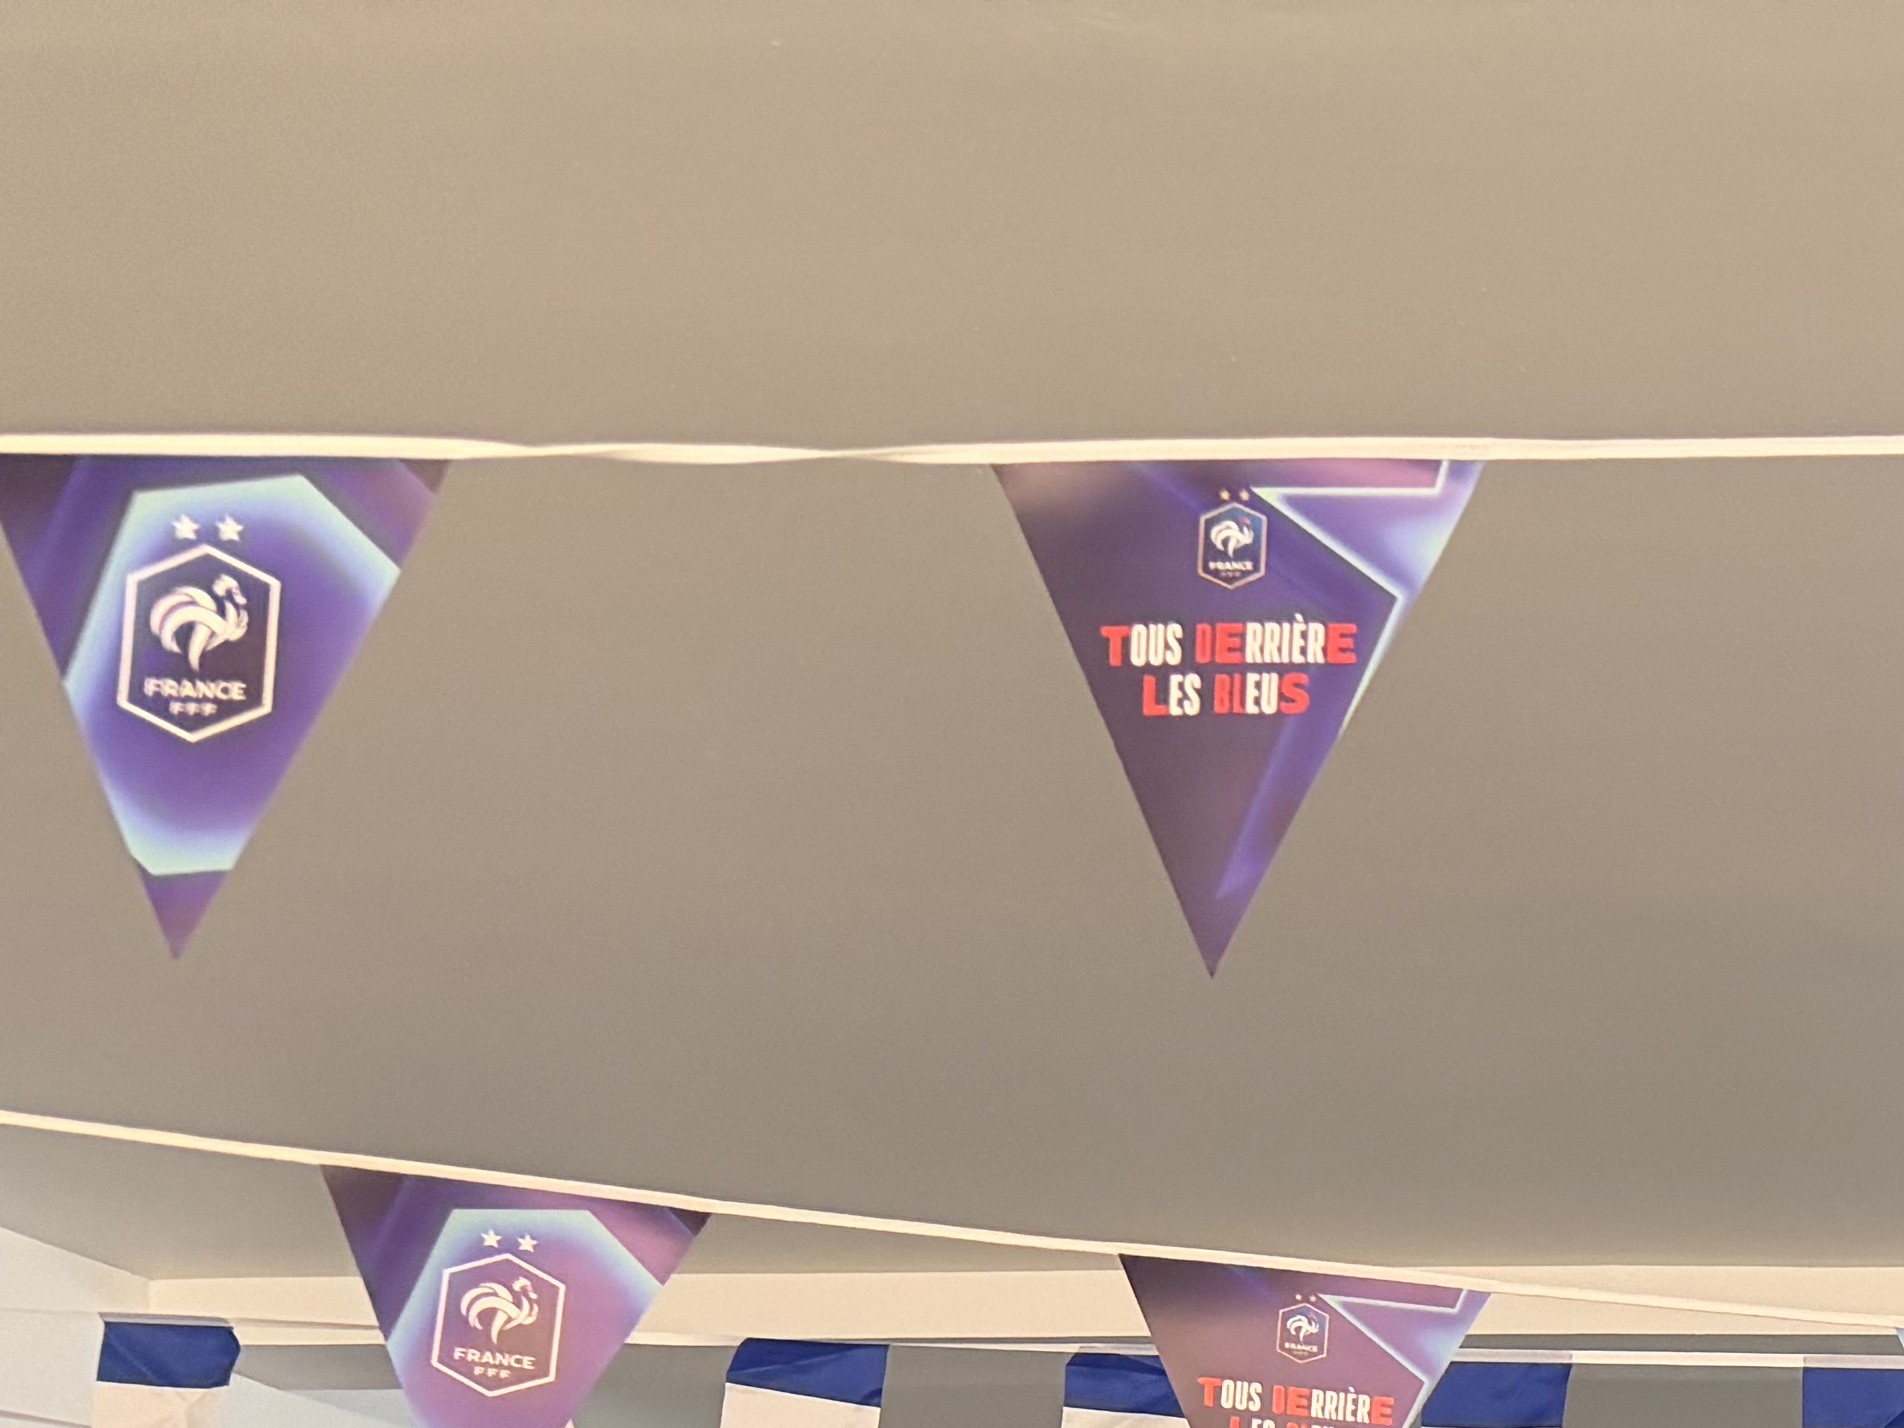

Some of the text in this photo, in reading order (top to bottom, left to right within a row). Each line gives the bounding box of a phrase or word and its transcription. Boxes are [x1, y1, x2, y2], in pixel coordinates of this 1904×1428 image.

[1100, 613, 1358, 667] TOUS DERRIÈRE
[144, 678, 247, 700] FRANCE
[1142, 671, 1311, 717] LES BLEUS
[454, 1347, 537, 1369] FRANCE
[1197, 1376, 1394, 1427] TOUS DERRIÈRE
